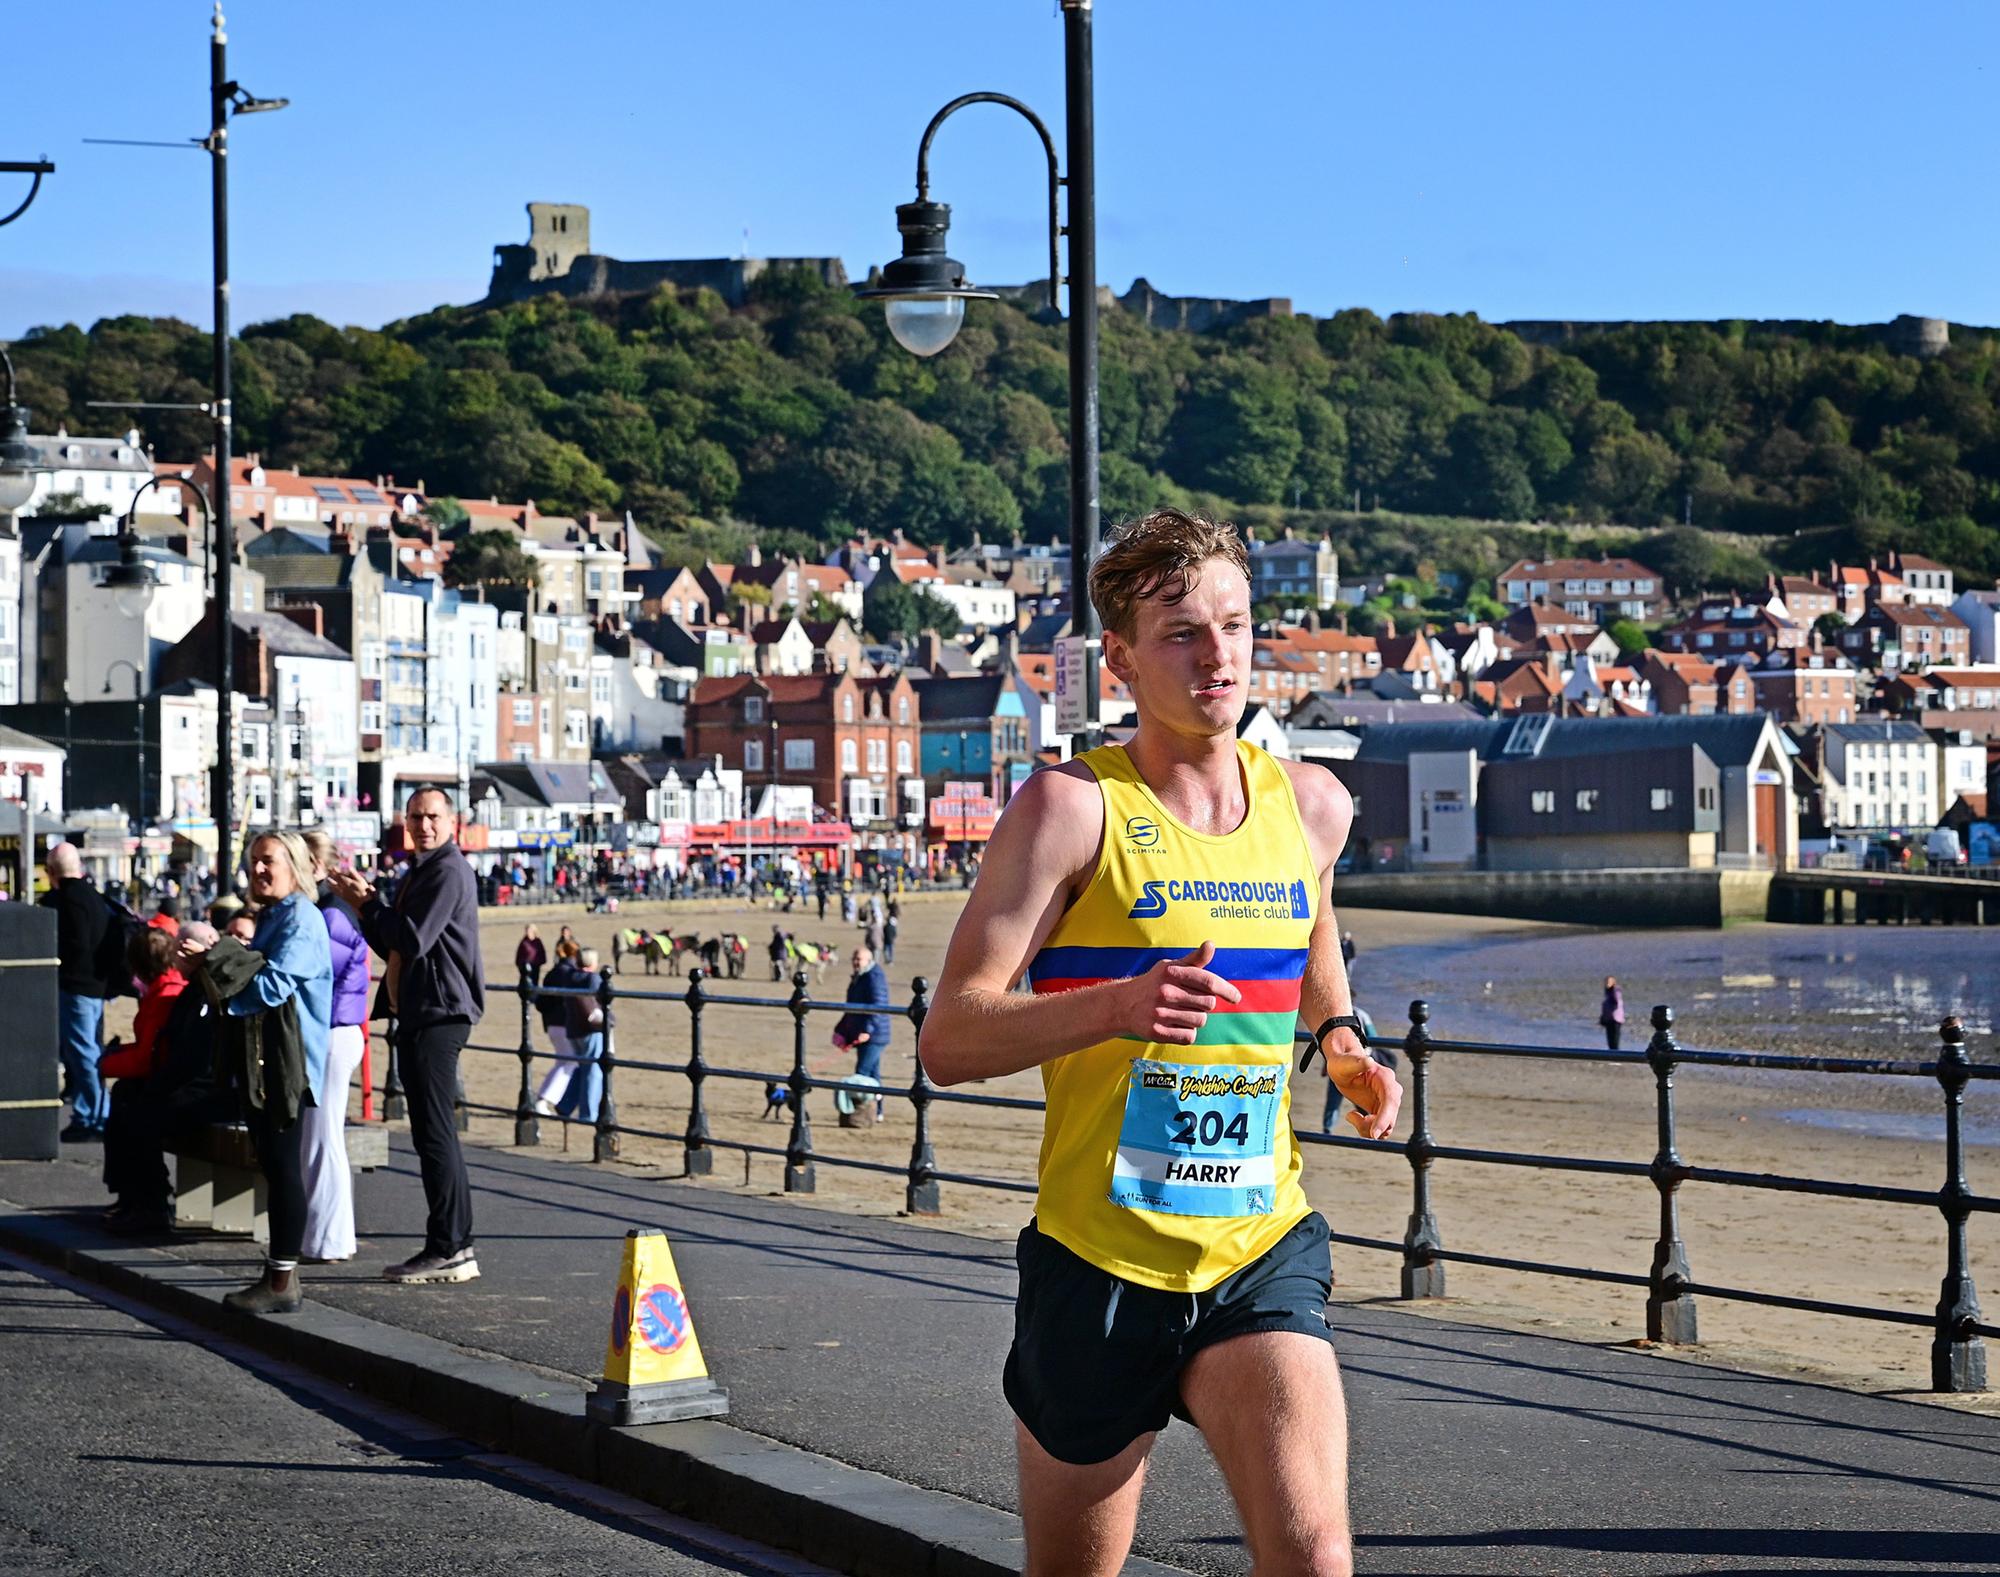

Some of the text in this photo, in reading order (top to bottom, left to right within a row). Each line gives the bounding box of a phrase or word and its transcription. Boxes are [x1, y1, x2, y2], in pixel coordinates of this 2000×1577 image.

[1057, 643, 1065, 667] P
[1210, 905, 1290, 919] athletic club
[1179, 1074, 1232, 1101] Yorkshire
[1231, 1075, 1264, 1098] Coast
[1169, 1110, 1249, 1147] 204
[1165, 1161, 1241, 1183] HARRY
[1161, 1200, 1172, 1208] ALL
